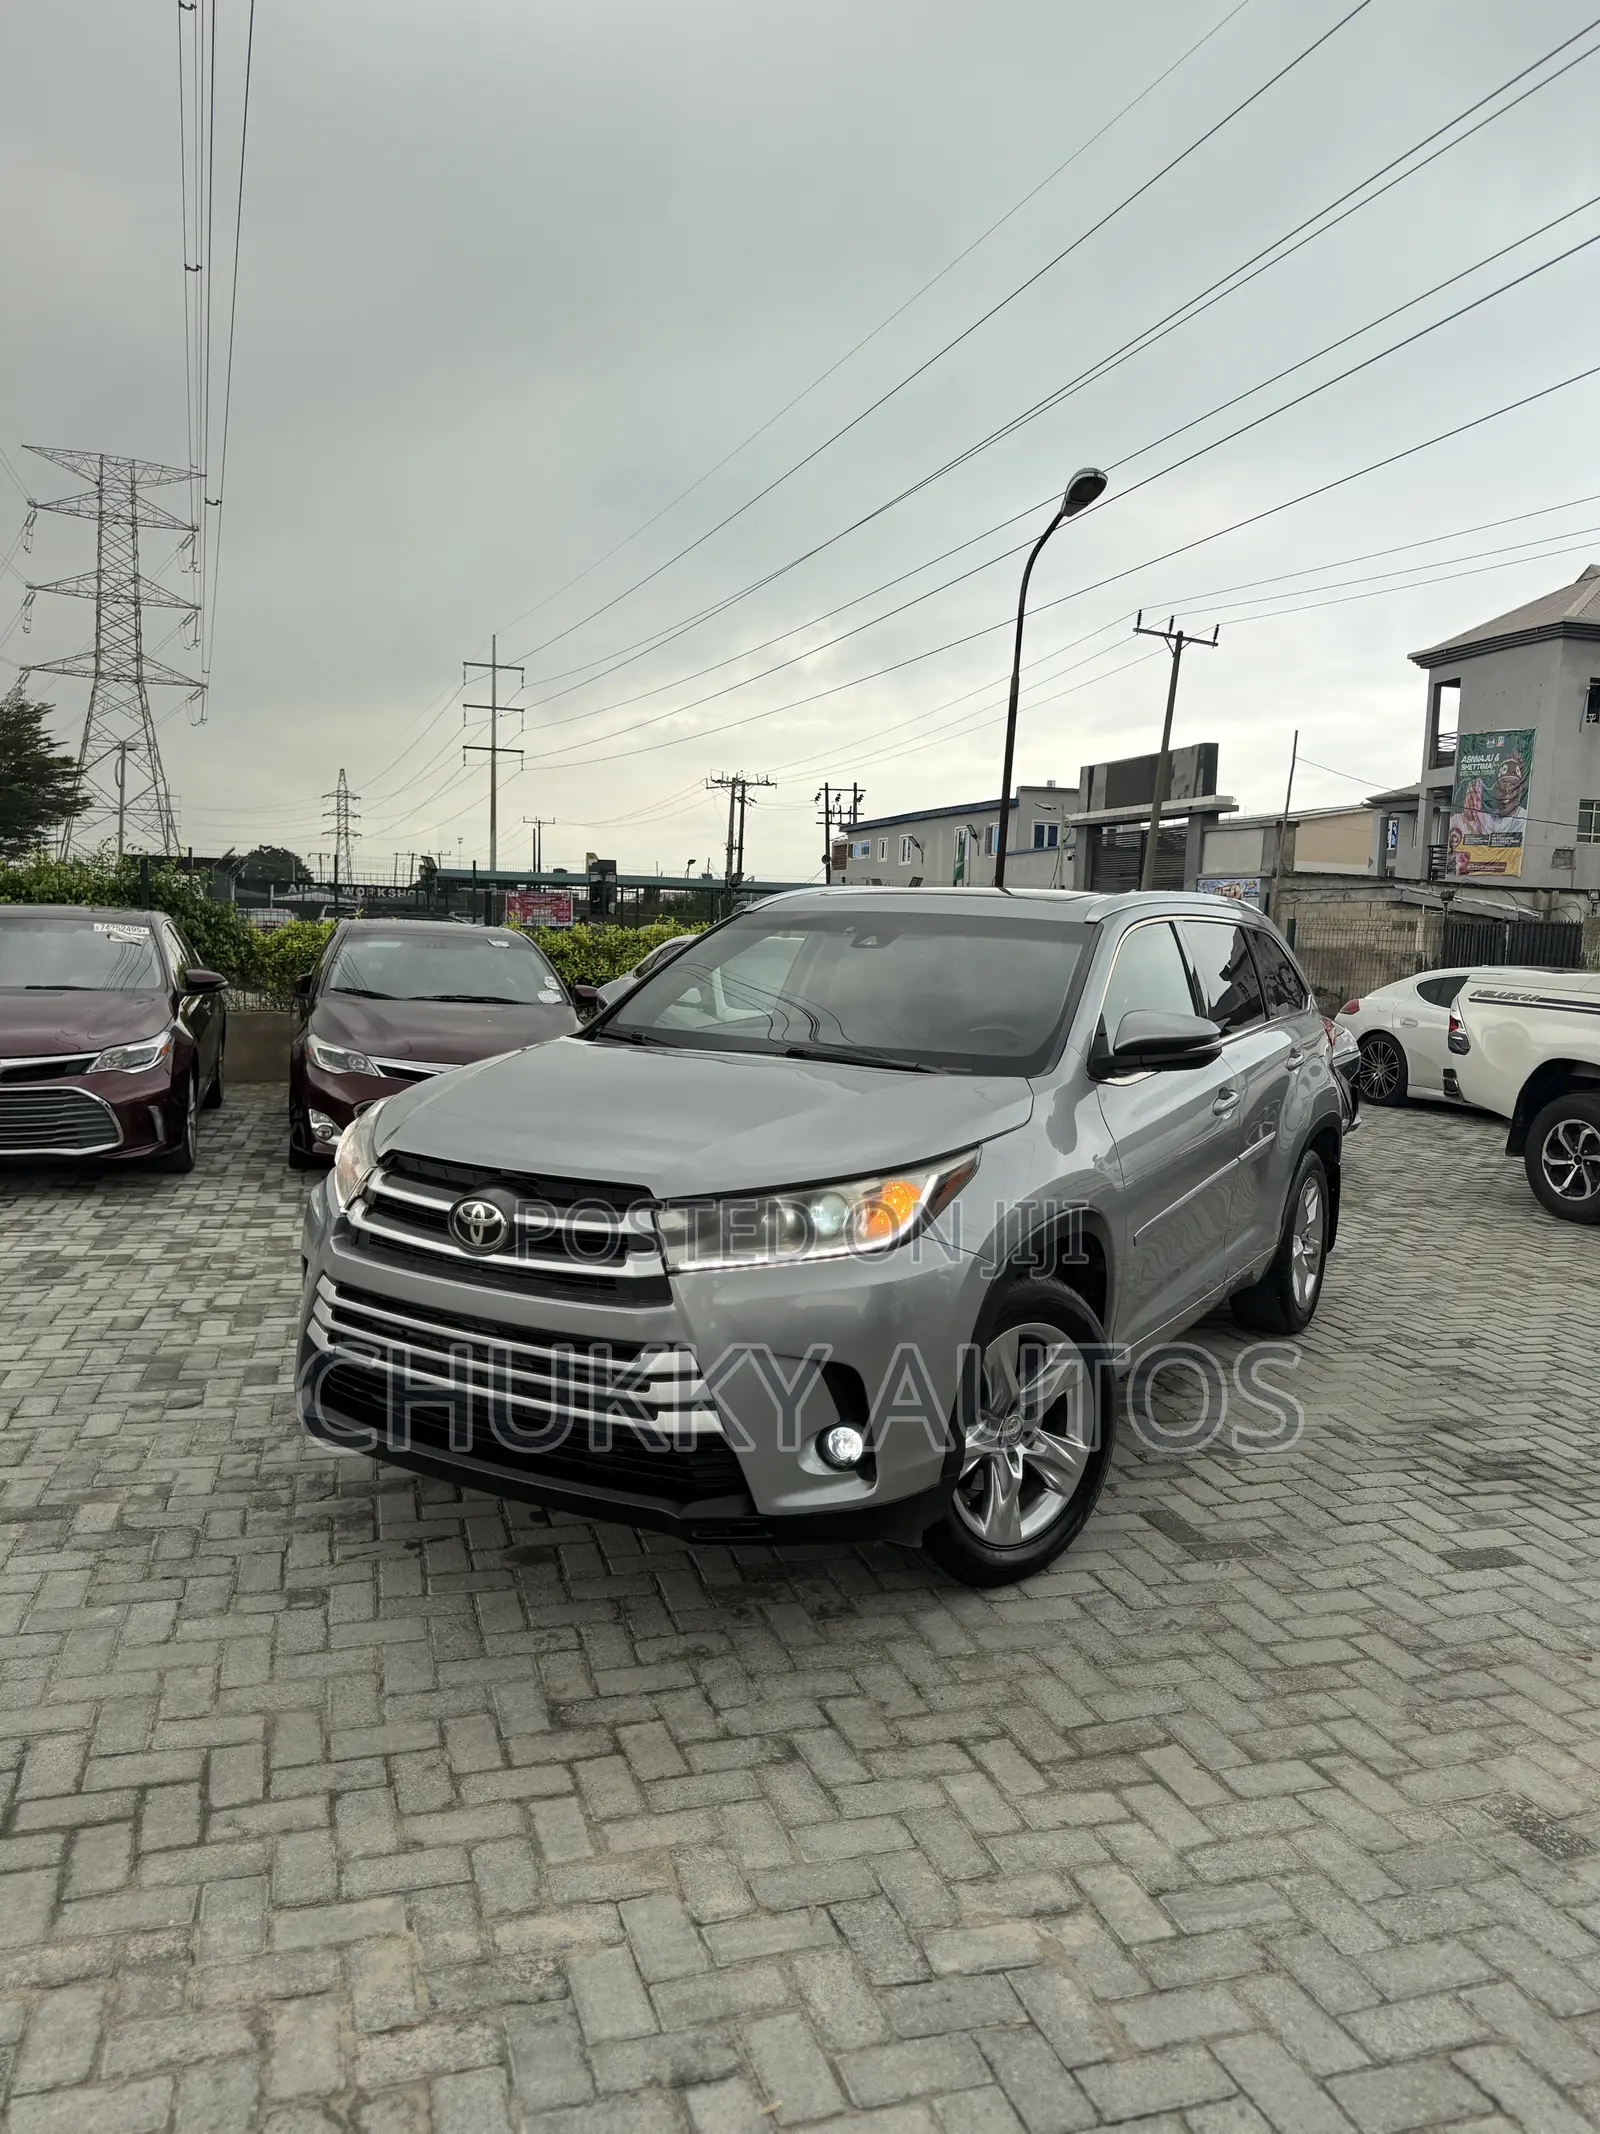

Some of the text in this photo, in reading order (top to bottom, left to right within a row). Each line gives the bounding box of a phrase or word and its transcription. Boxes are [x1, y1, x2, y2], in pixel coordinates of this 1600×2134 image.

[1460, 753, 1500, 764] ASIWAJU &
[1460, 763, 1492, 771] SHETTIMA
[1459, 769, 1481, 777] SECOND
